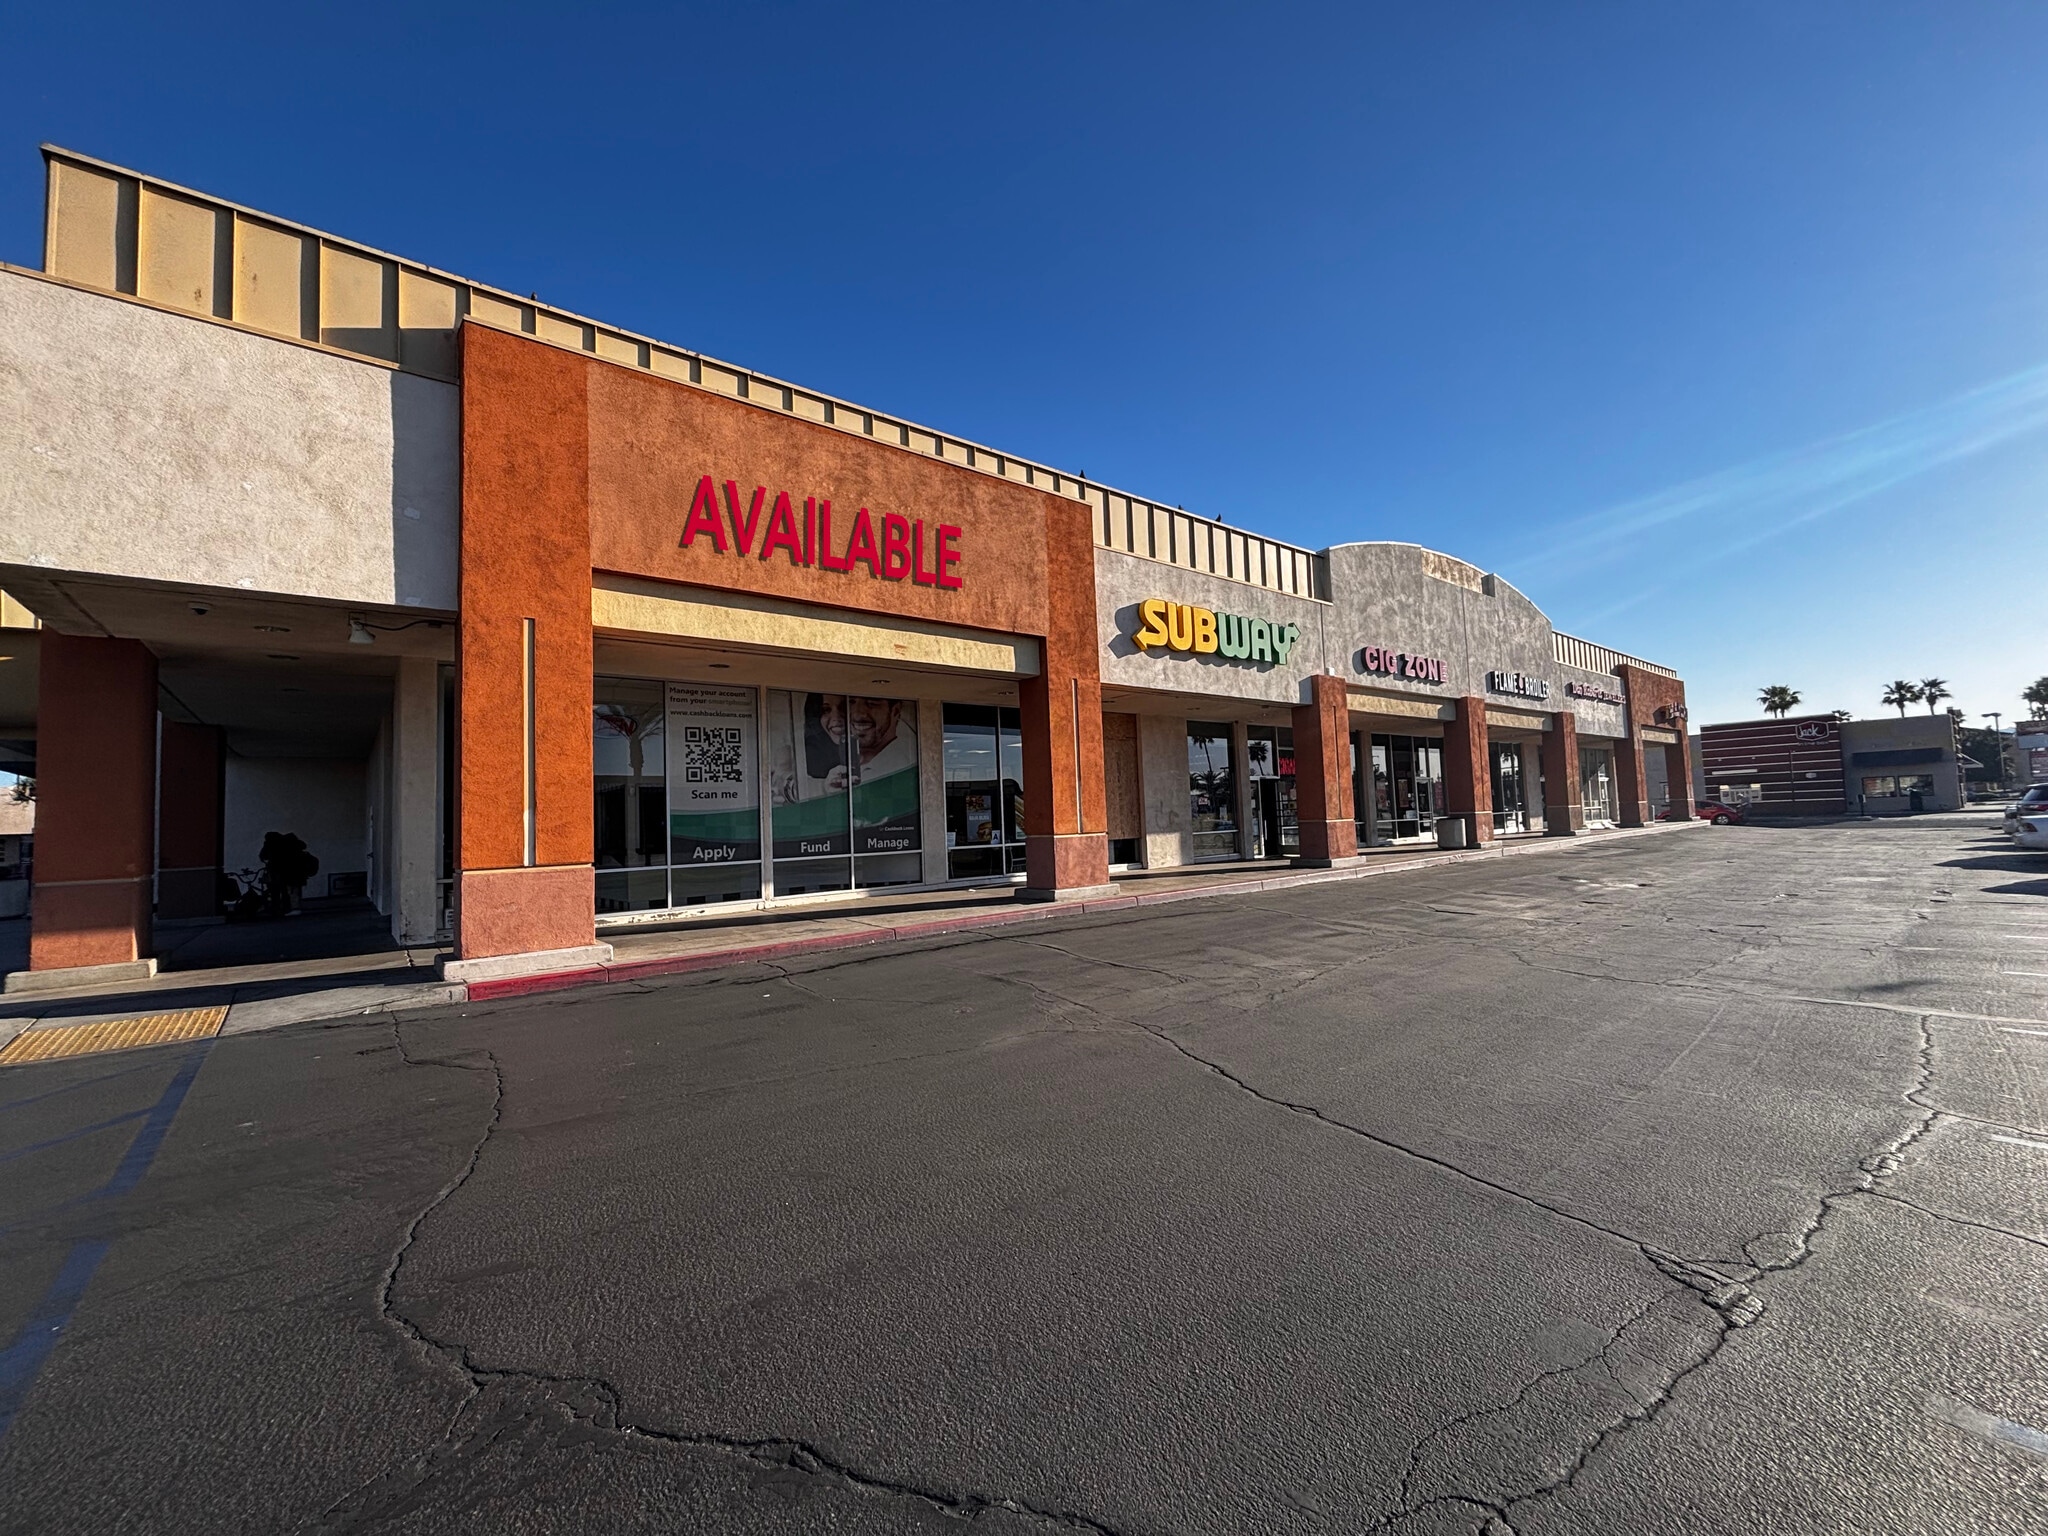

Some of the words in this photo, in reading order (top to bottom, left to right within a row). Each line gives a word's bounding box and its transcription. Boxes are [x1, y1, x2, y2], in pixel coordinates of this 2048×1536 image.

[680, 474, 963, 589] AVAILABLE
[1132, 598, 1301, 665] SUBWAY
[1363, 645, 1398, 674] CIG
[1403, 653, 1448, 682] ZONE
[1494, 670, 1519, 693] FLAME
[1524, 676, 1551, 698] BROILER
[669, 687, 699, 696] Manage
[700, 689, 717, 697] your
[1799, 723, 1826, 738] Jack
[691, 789, 718, 799] Scan
[721, 791, 738, 799] me
[867, 838, 910, 850] Manage
[993, 832, 999, 841] A
[692, 844, 736, 862] Apply
[800, 840, 831, 853] Fund
